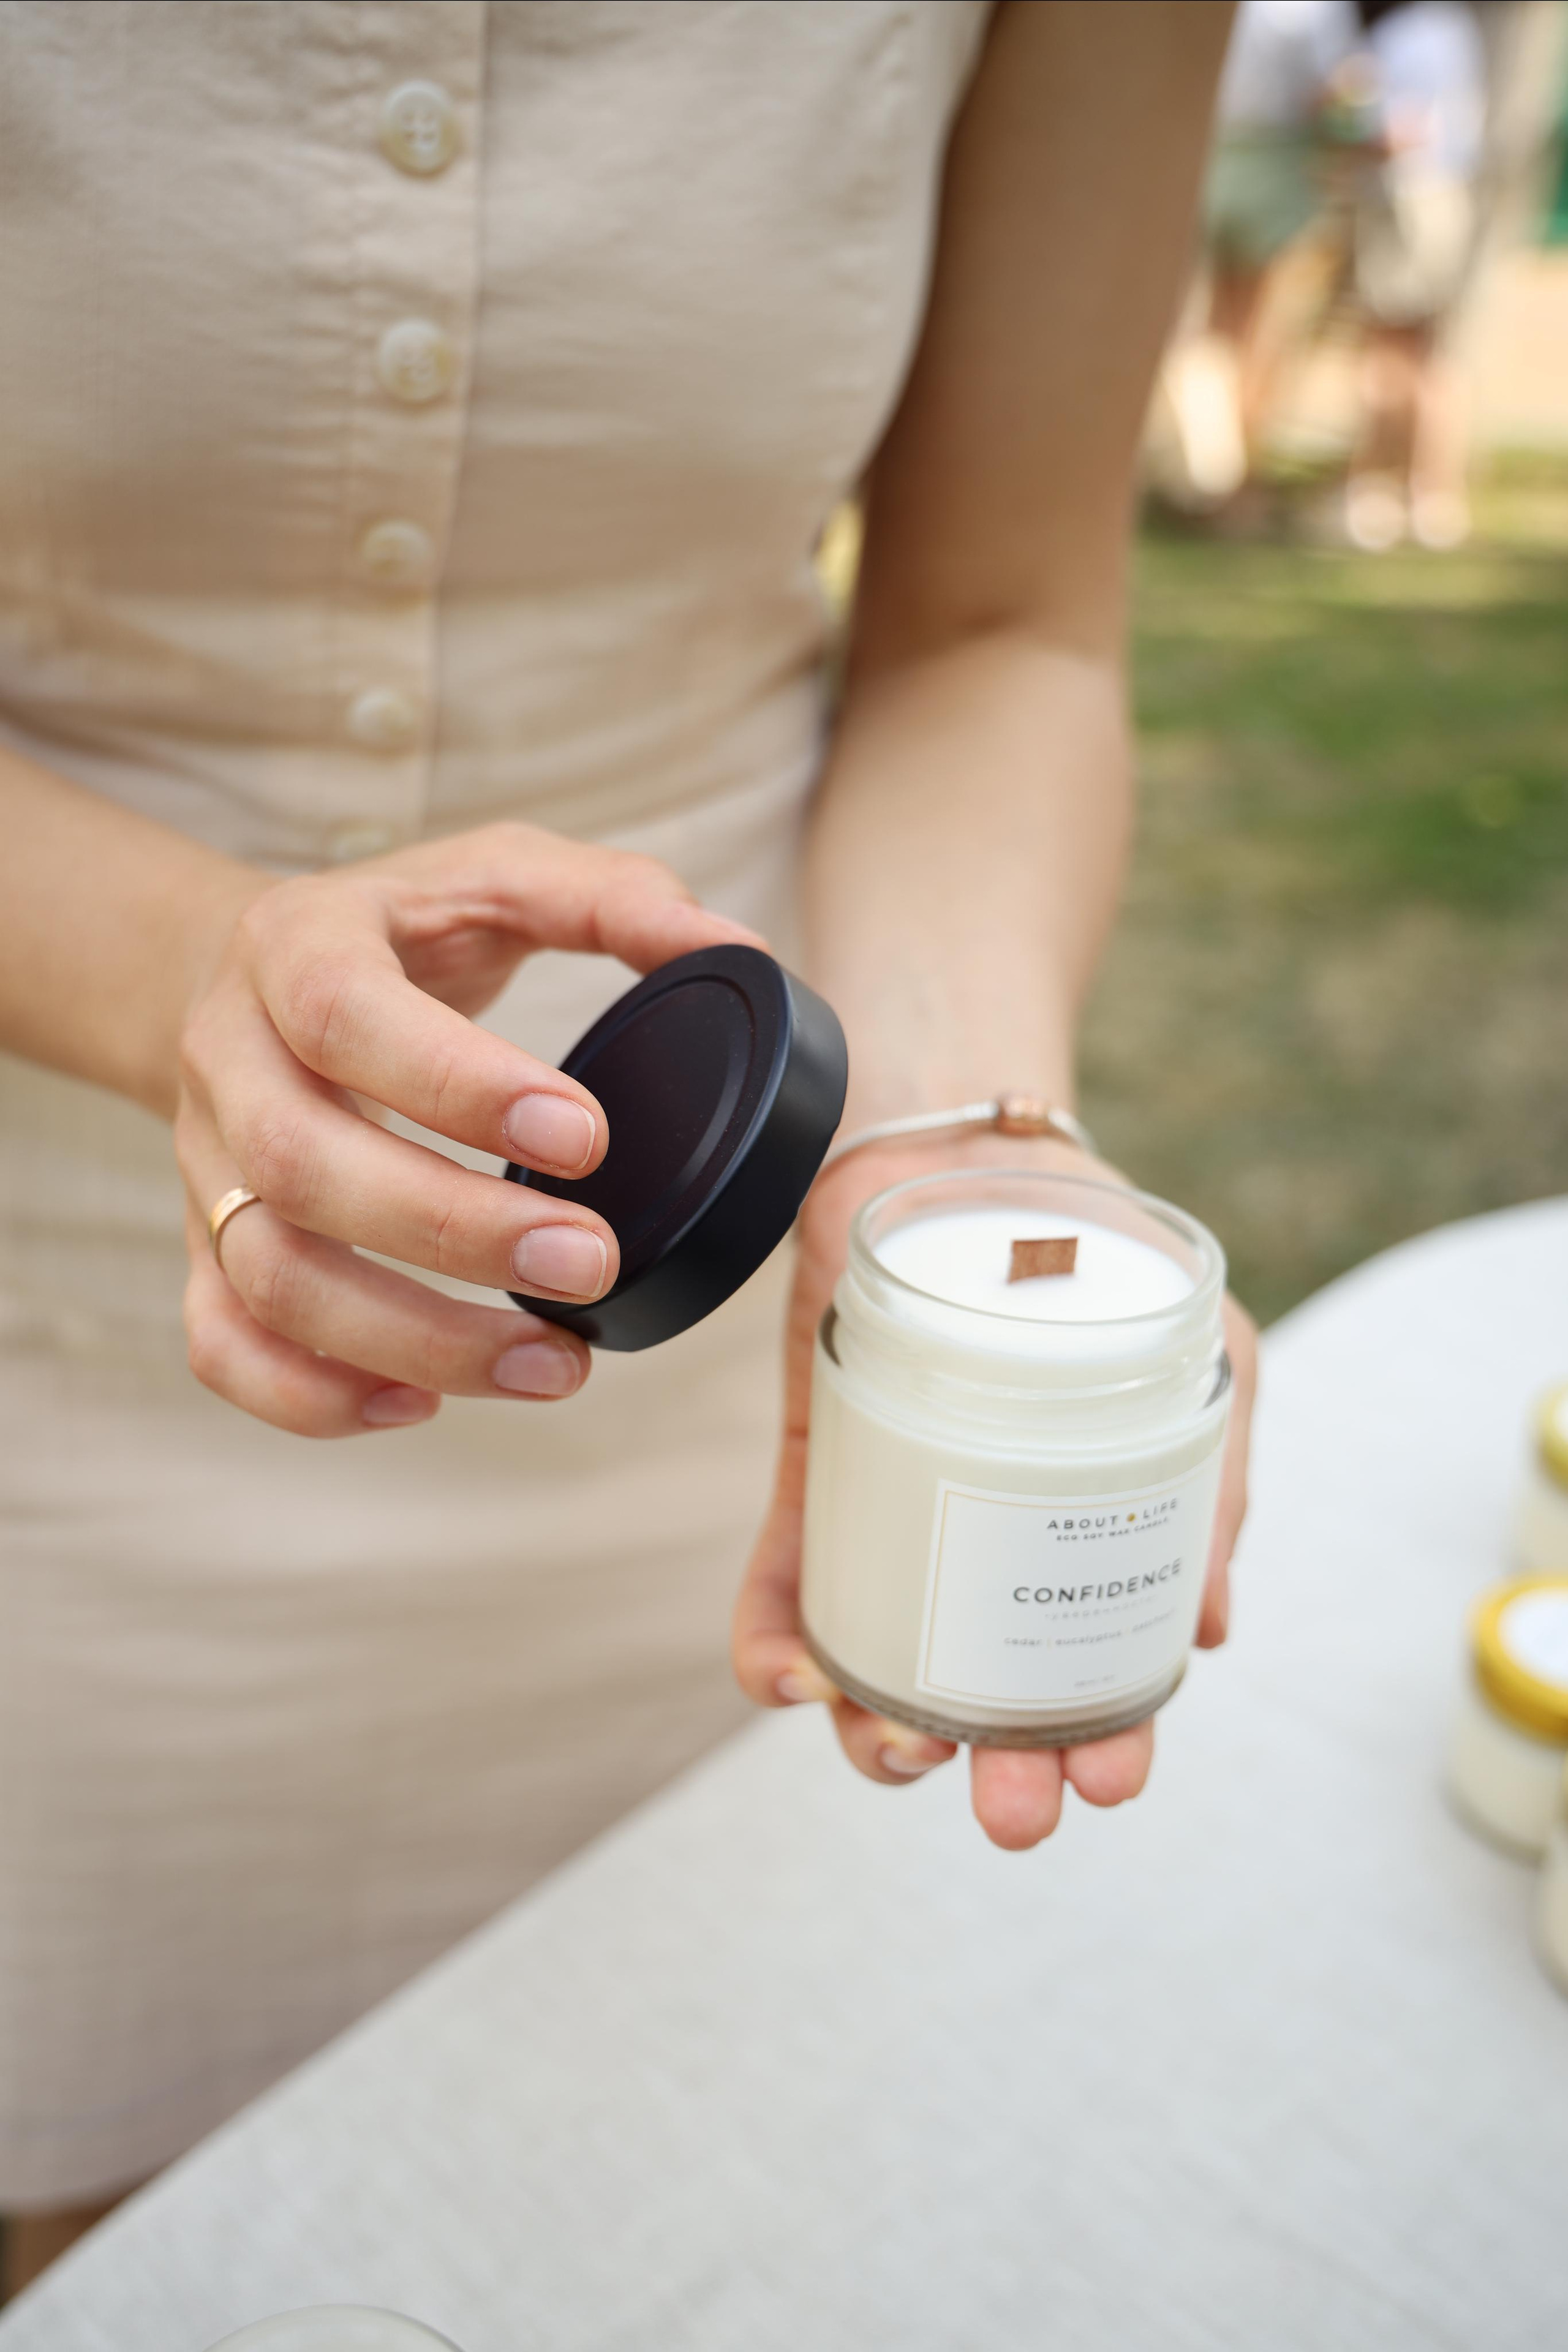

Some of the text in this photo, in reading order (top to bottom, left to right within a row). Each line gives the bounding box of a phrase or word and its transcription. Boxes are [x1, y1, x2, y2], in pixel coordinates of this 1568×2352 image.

[1047, 1498, 1177, 1529] ABOUT LIFE
[1012, 1558, 1182, 1603] CONFIDENCE
